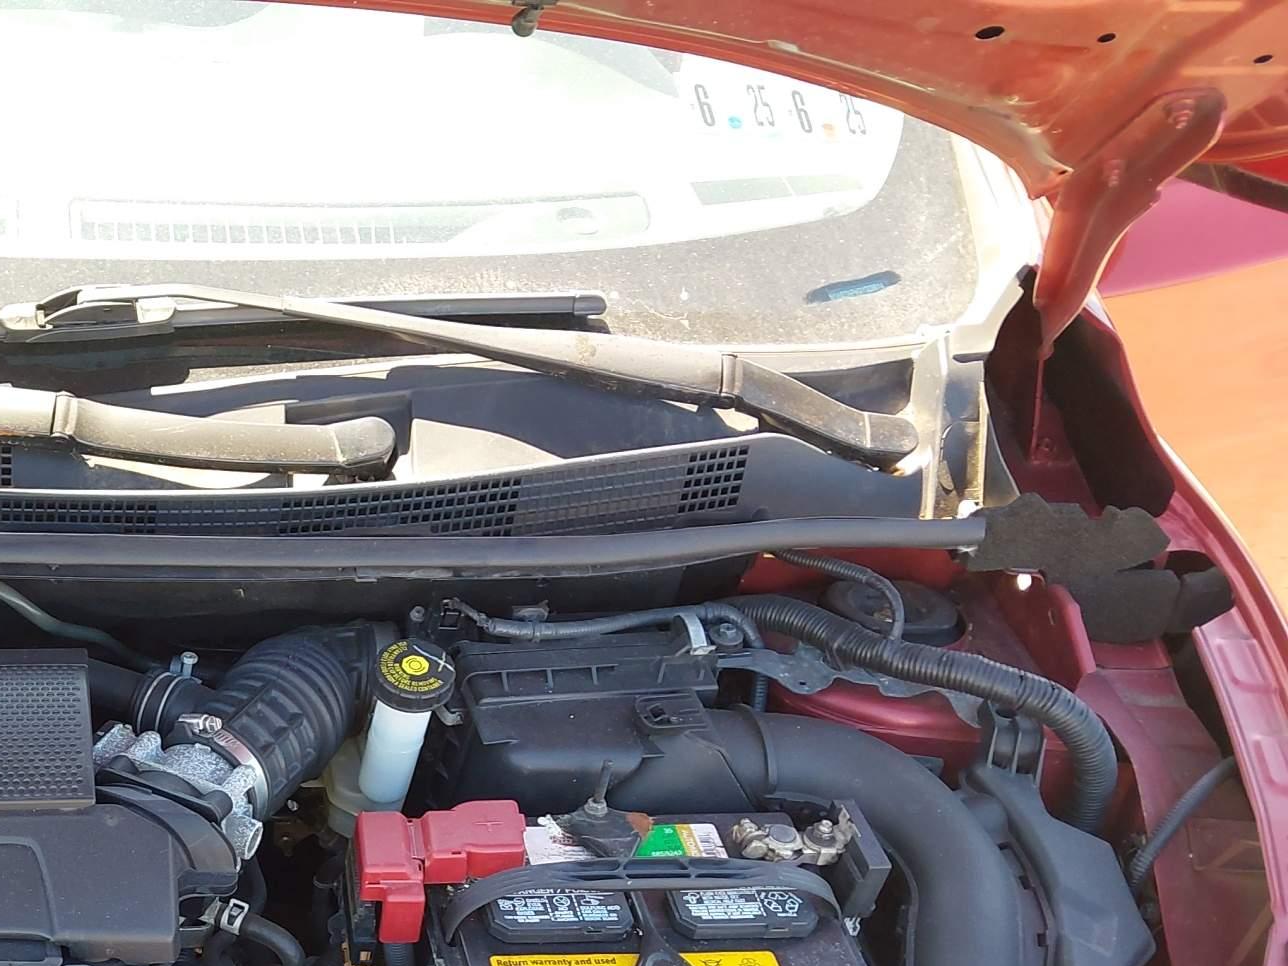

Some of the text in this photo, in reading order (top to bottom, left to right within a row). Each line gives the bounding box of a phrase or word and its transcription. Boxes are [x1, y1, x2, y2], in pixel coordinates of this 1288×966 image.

[694, 84, 715, 127] 6
[791, 90, 813, 134] 6
[496, 957, 617, 966] Return warranty and used
